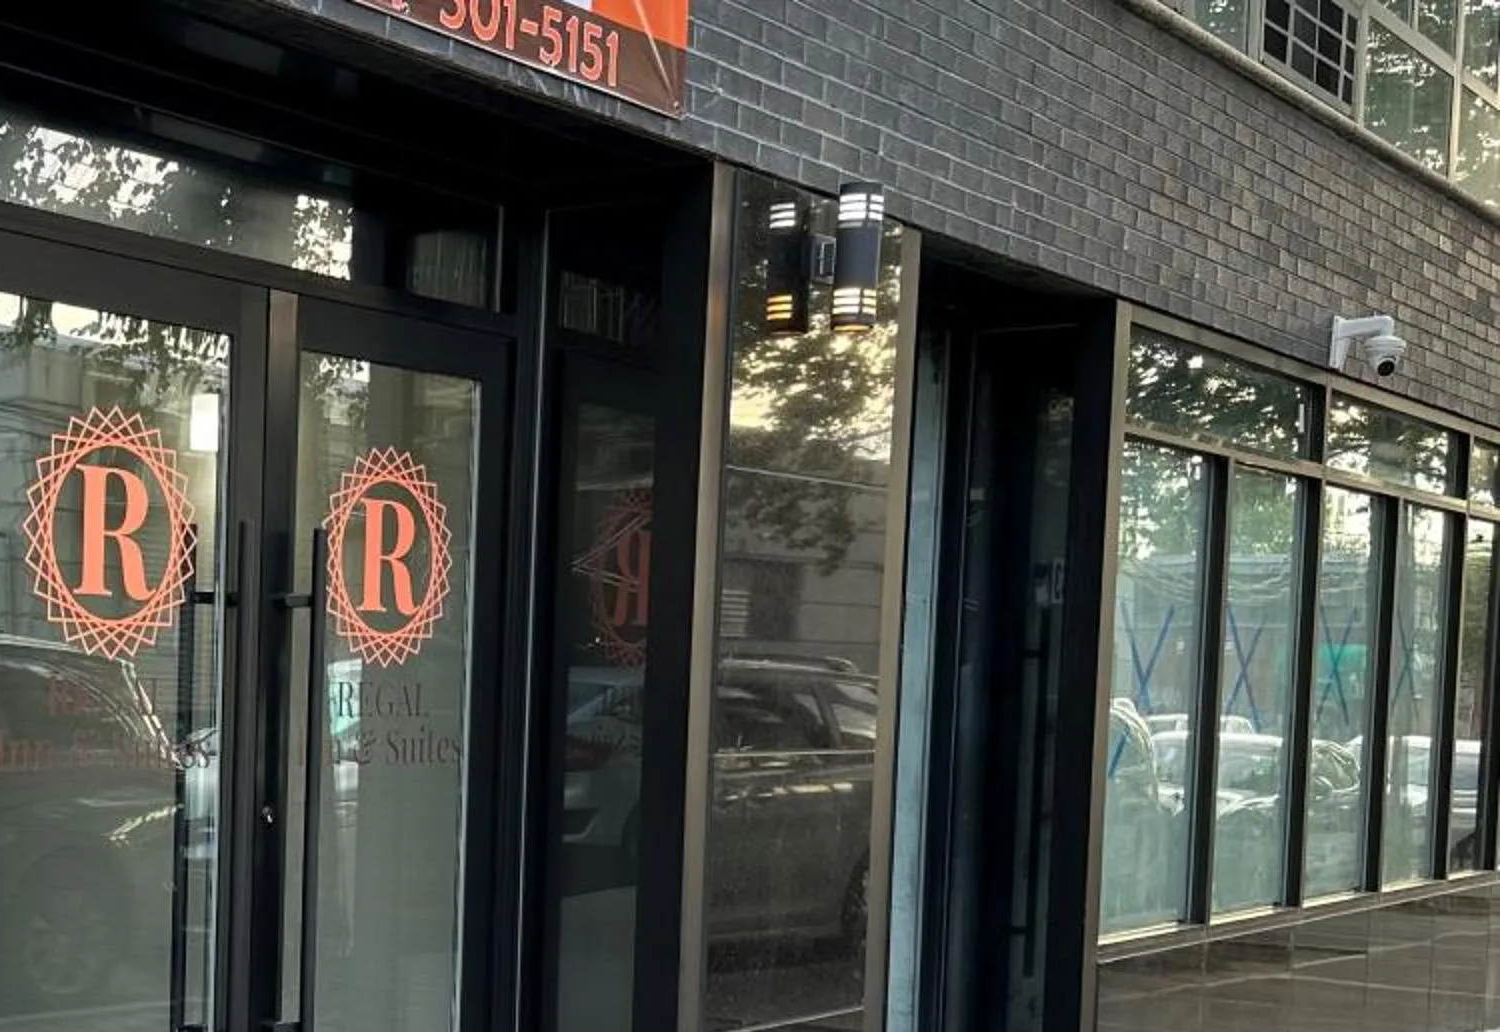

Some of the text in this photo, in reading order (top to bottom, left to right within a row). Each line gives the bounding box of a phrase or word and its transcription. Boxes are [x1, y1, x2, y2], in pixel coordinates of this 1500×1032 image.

[73, 463, 157, 601] R
[355, 497, 422, 615] R
[338, 681, 431, 718] REGAL
[384, 723, 463, 767] Suites
